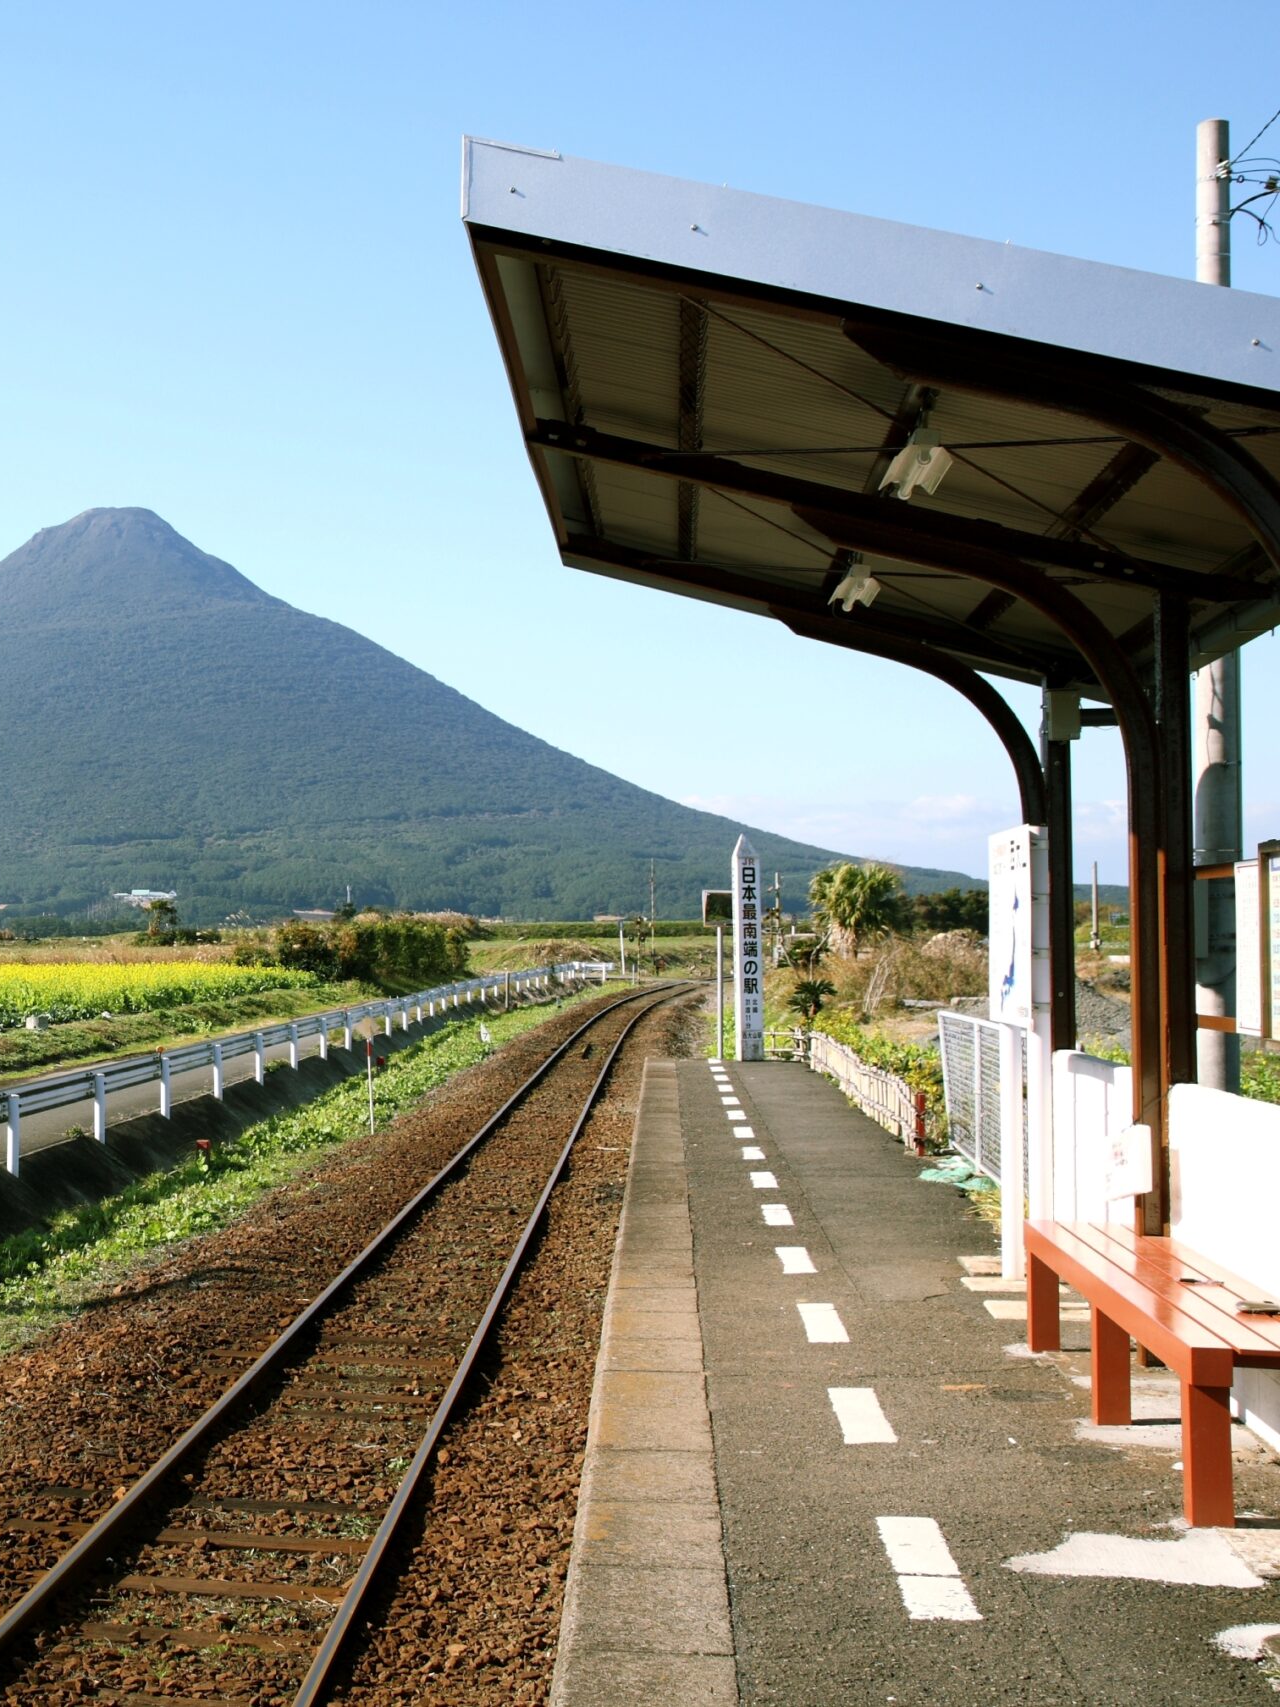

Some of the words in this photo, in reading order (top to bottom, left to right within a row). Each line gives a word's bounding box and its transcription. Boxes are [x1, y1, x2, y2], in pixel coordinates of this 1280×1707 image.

[741, 857, 755, 866] JR
[742, 867, 759, 994] 日本最南端の駅
